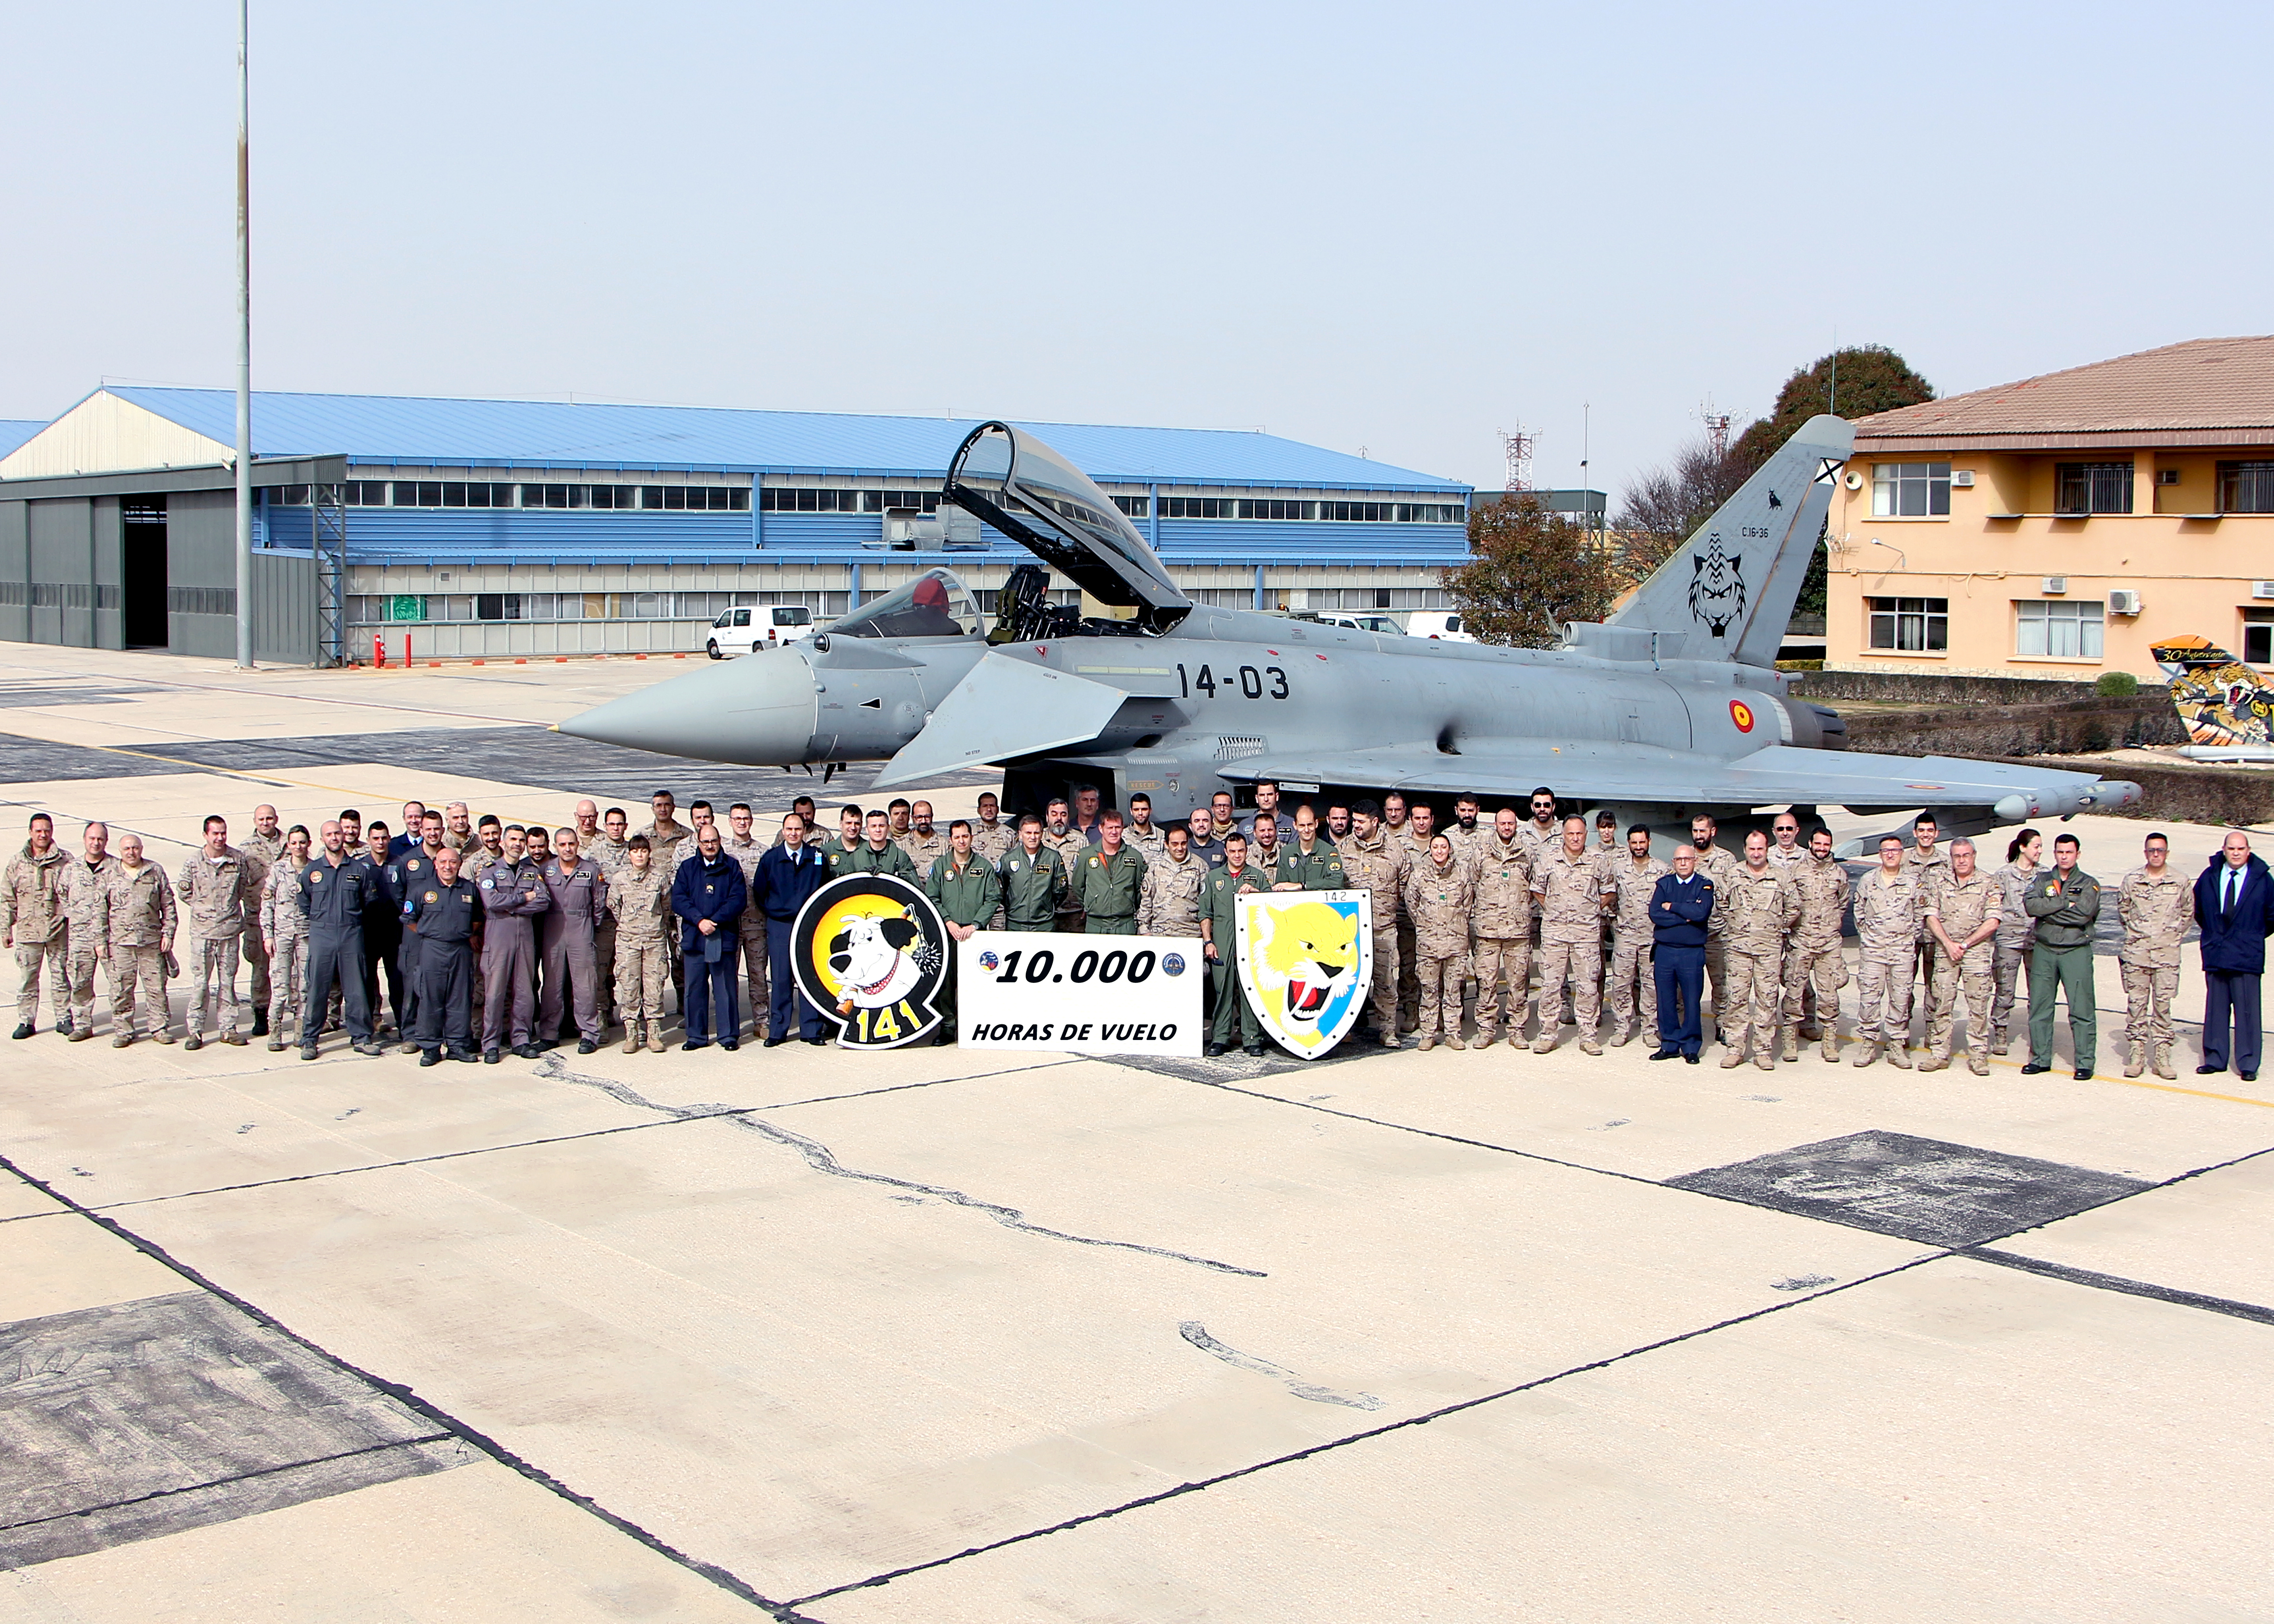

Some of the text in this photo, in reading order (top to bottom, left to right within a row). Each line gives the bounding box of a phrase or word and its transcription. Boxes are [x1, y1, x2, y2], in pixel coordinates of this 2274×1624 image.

[1742, 527, 1768, 538] C.16-36
[2158, 650, 2182, 661] 30
[1177, 663, 1289, 699] 14-03
[1325, 892, 1347, 902] 142
[996, 950, 1156, 983] 10.000
[857, 999, 922, 1042] 141
[971, 1024, 1177, 1041] HORAS DE VUELO
